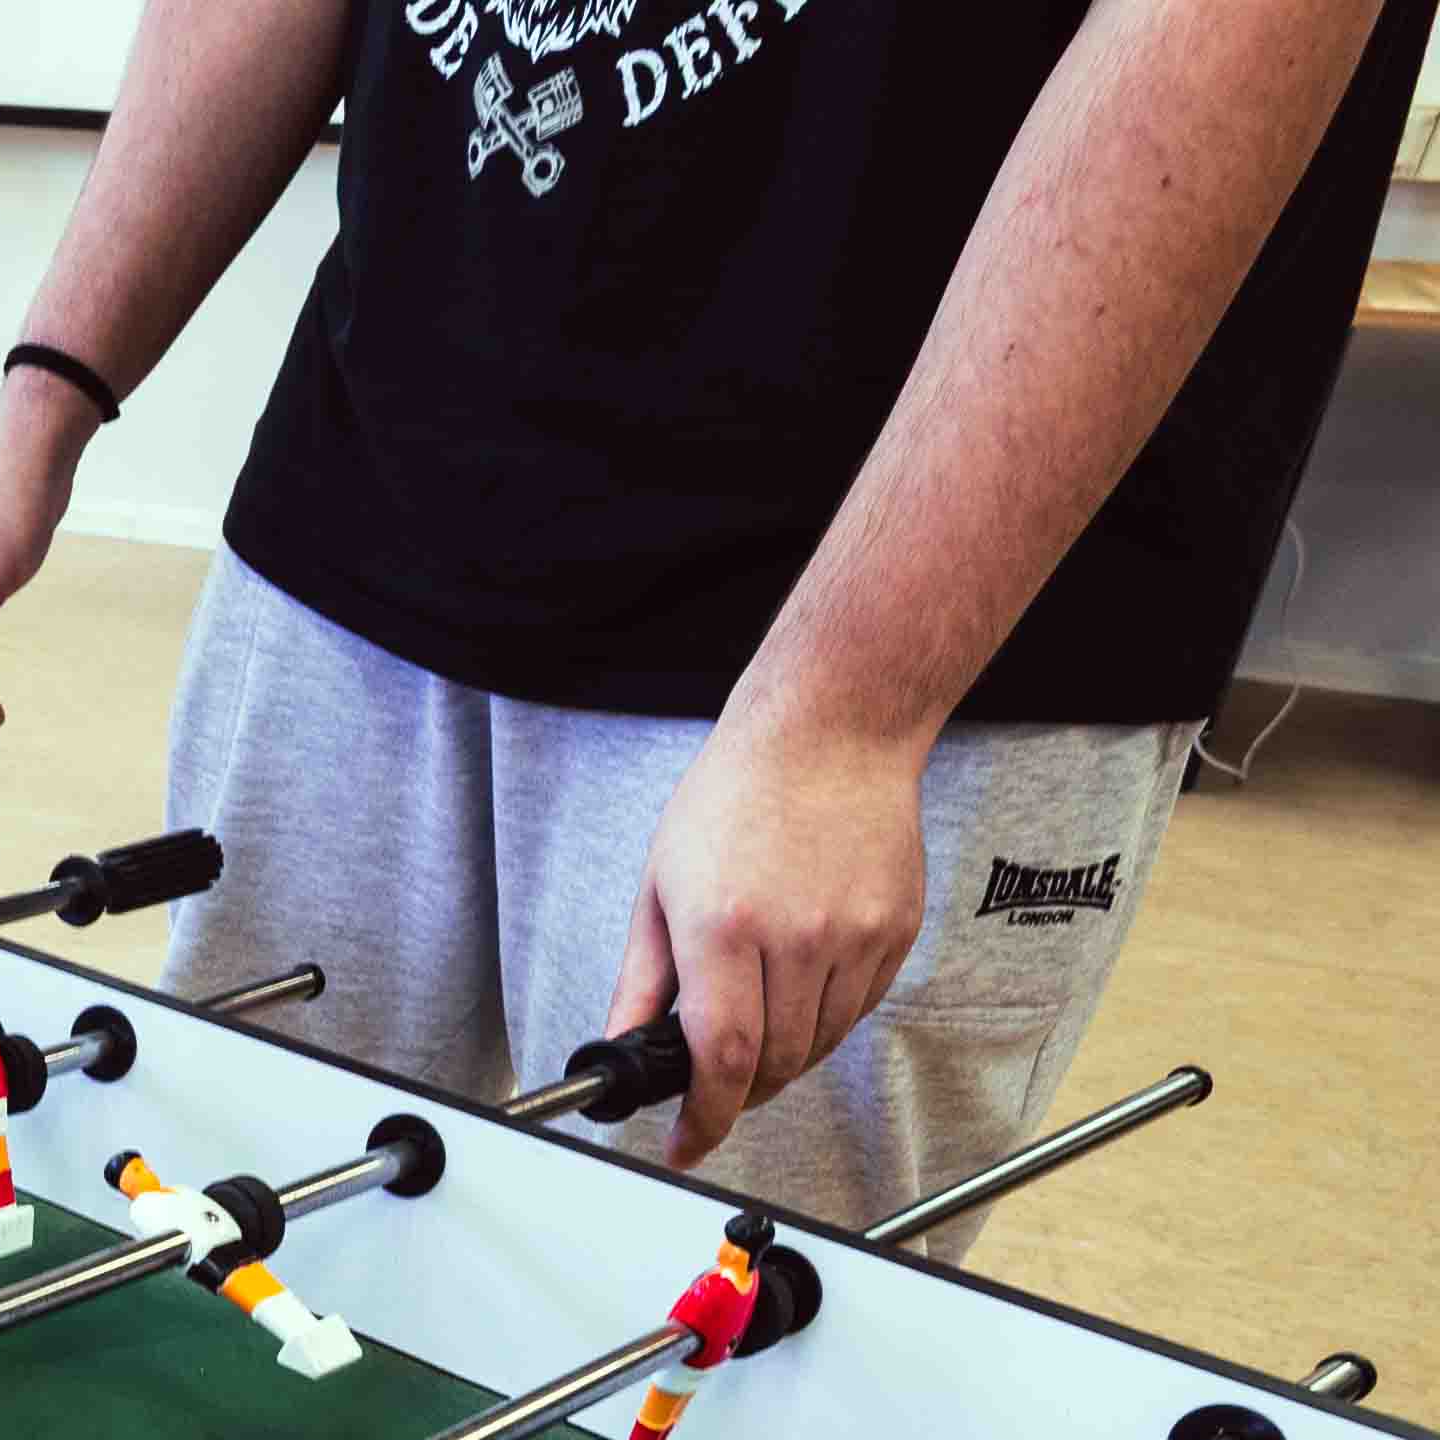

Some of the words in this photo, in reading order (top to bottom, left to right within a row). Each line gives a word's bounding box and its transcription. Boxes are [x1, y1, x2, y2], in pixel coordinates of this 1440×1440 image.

[617, 0, 808, 128] DEF
[975, 853, 1120, 918] LONSDALE
[1007, 909, 1075, 926] LONDON
